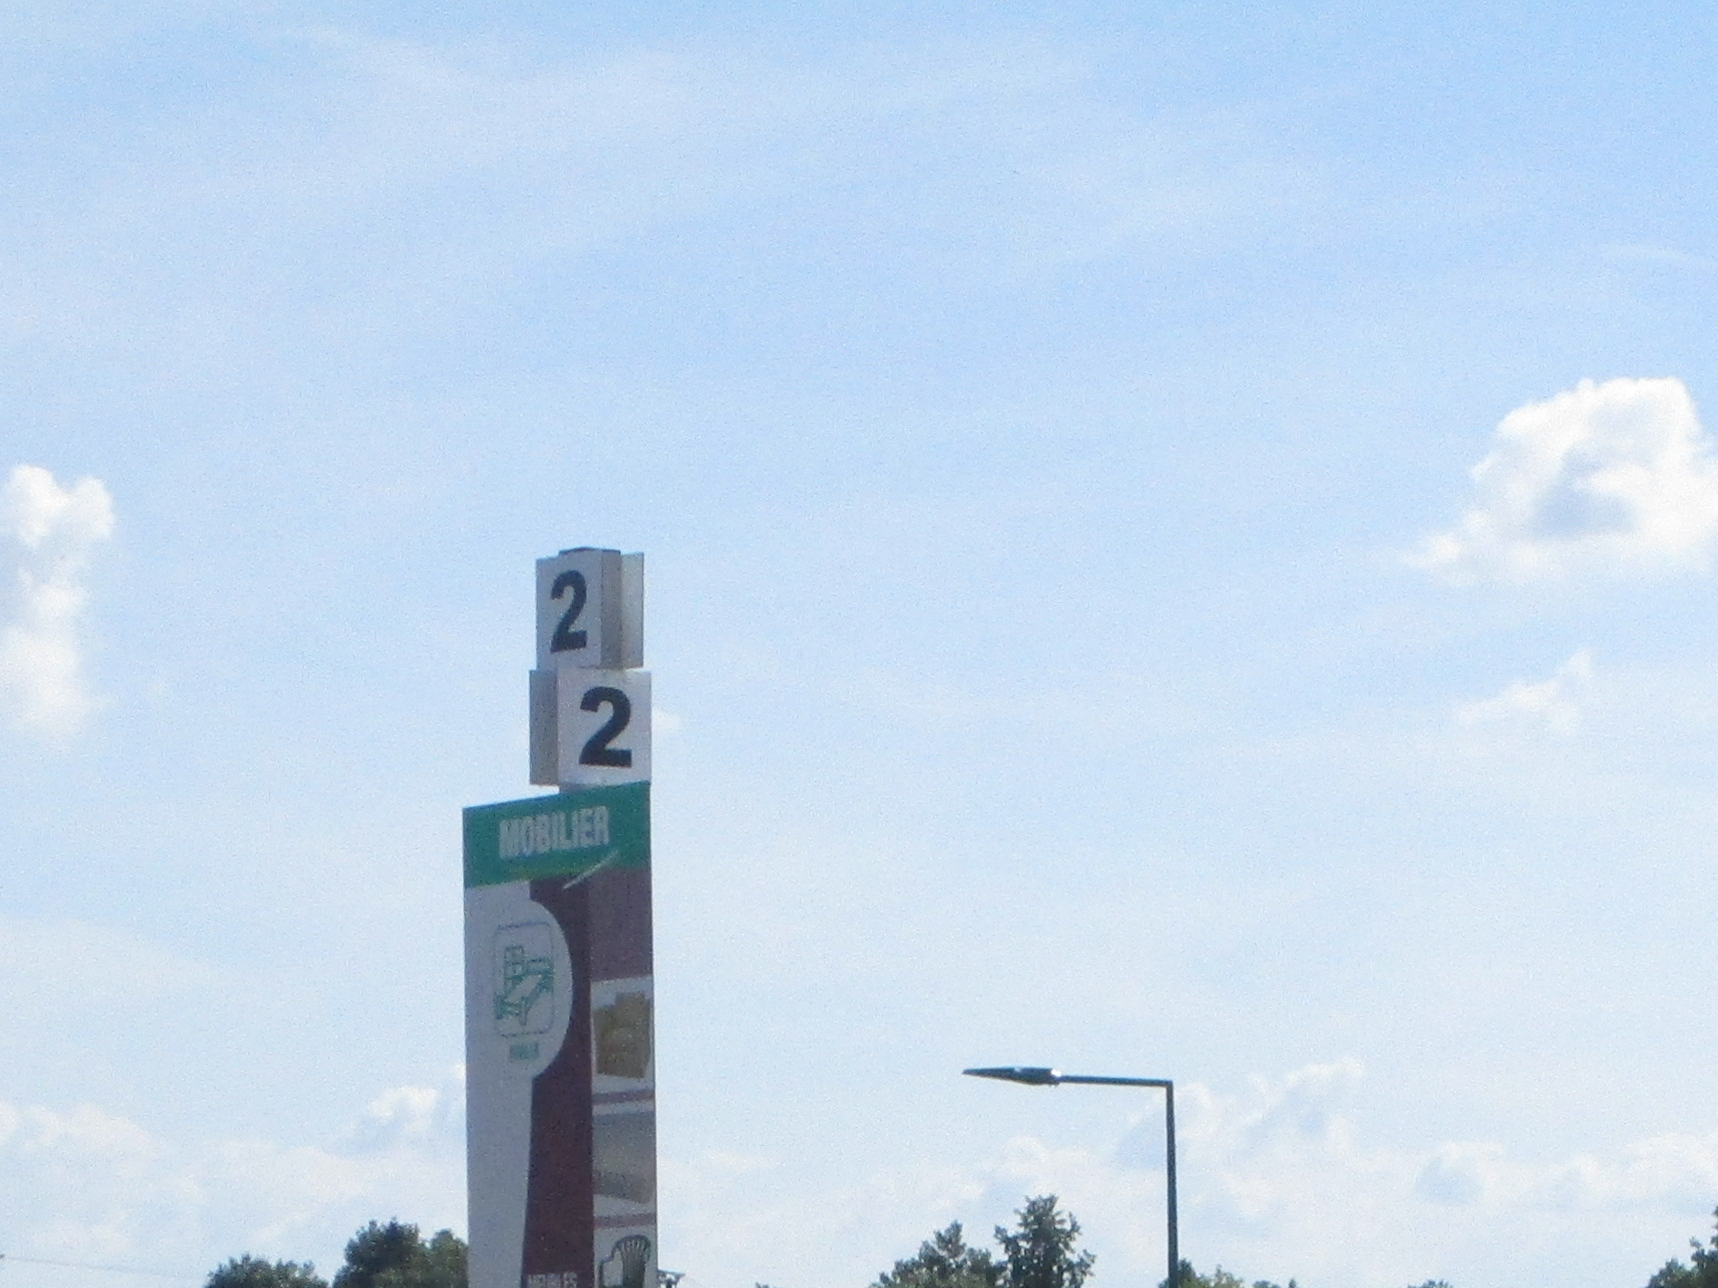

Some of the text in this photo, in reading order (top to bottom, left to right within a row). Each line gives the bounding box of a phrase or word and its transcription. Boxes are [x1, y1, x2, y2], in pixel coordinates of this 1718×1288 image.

[551, 569, 587, 653] 2
[579, 686, 632, 768] 2
[498, 805, 610, 858] MOBILIER
